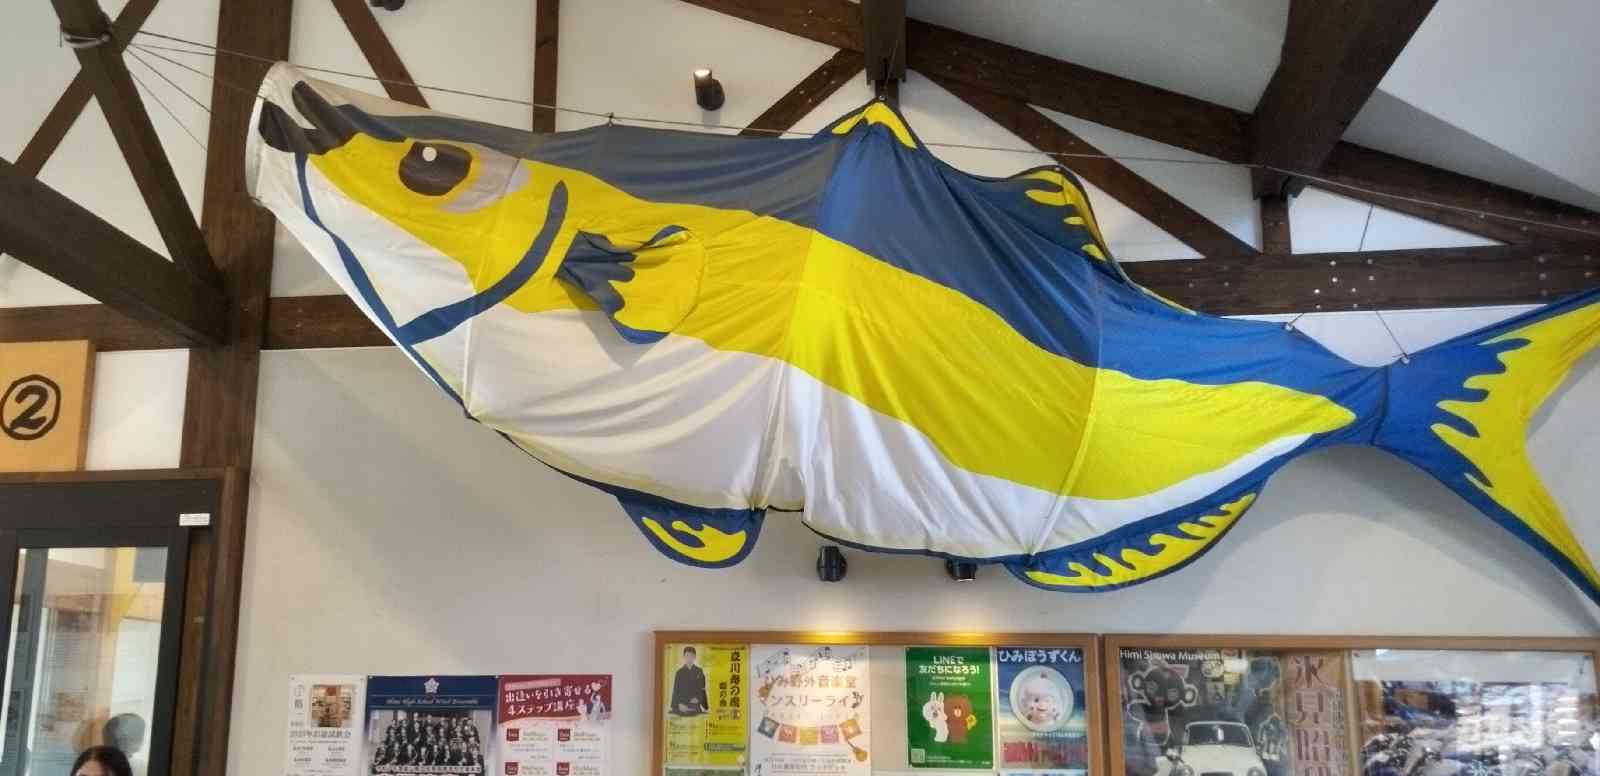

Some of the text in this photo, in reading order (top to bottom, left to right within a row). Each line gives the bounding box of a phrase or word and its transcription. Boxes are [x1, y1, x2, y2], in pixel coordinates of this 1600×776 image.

[933, 655, 964, 664] LINEで
[998, 650, 1081, 662] ひみぼうずくん
[1120, 650, 1142, 659] Himi
[1294, 655, 1325, 776] 氷見昭
